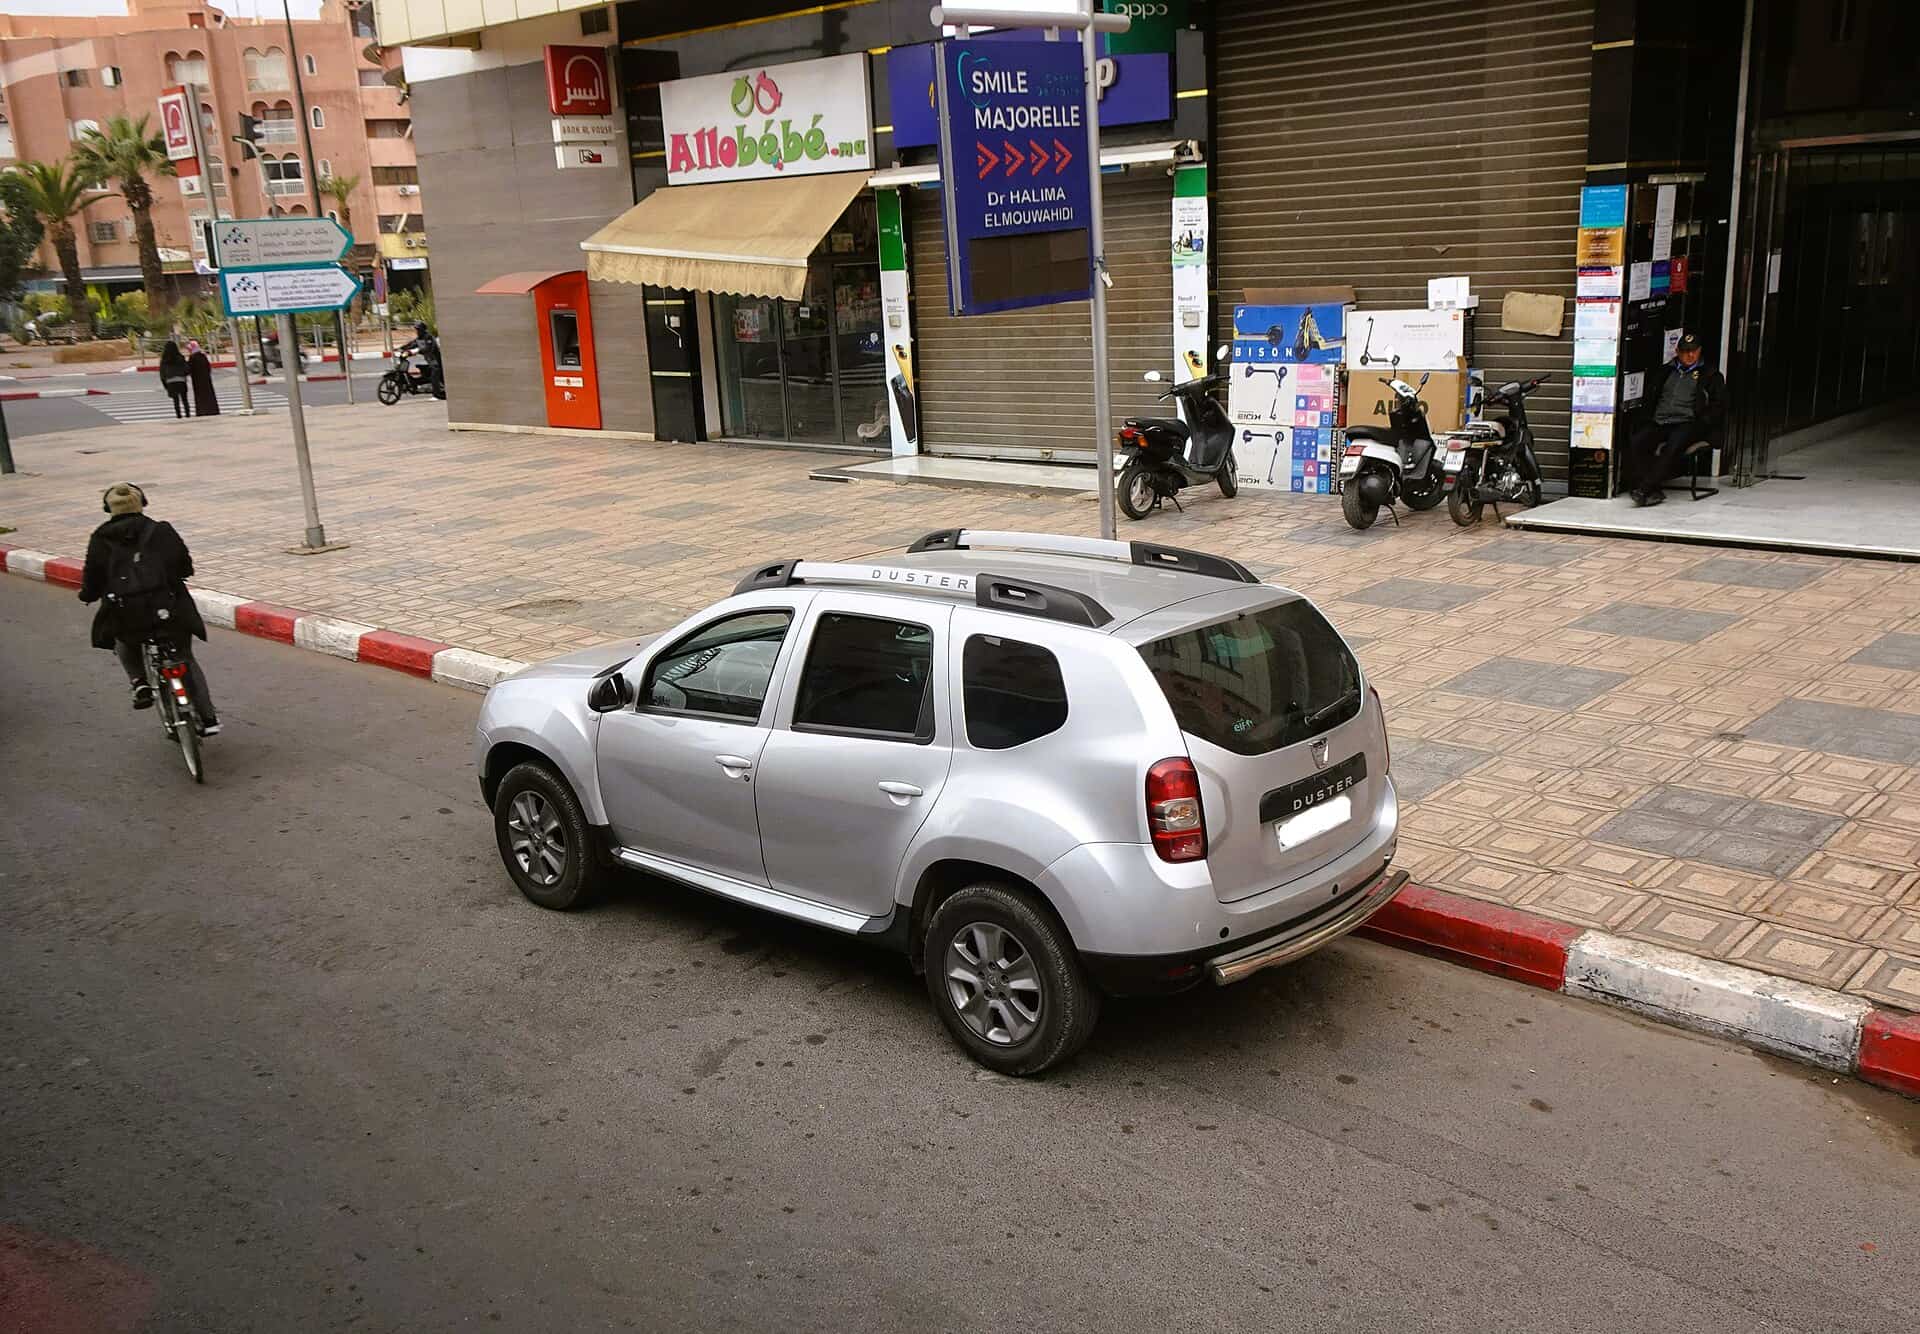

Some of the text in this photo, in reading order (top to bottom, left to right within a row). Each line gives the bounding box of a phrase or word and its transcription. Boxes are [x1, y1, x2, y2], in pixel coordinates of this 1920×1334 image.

[972, 70, 1028, 95] SMILE
[975, 104, 1081, 131] MAJORELLE
[668, 114, 866, 174] Allobébé.ma
[987, 186, 1066, 207] Dr HALIMA
[984, 206, 1074, 229] ELMOUWAHIDI
[1235, 347, 1293, 357] BISON
[871, 568, 971, 591] DUSTER
[1293, 775, 1354, 811] DUSTER
